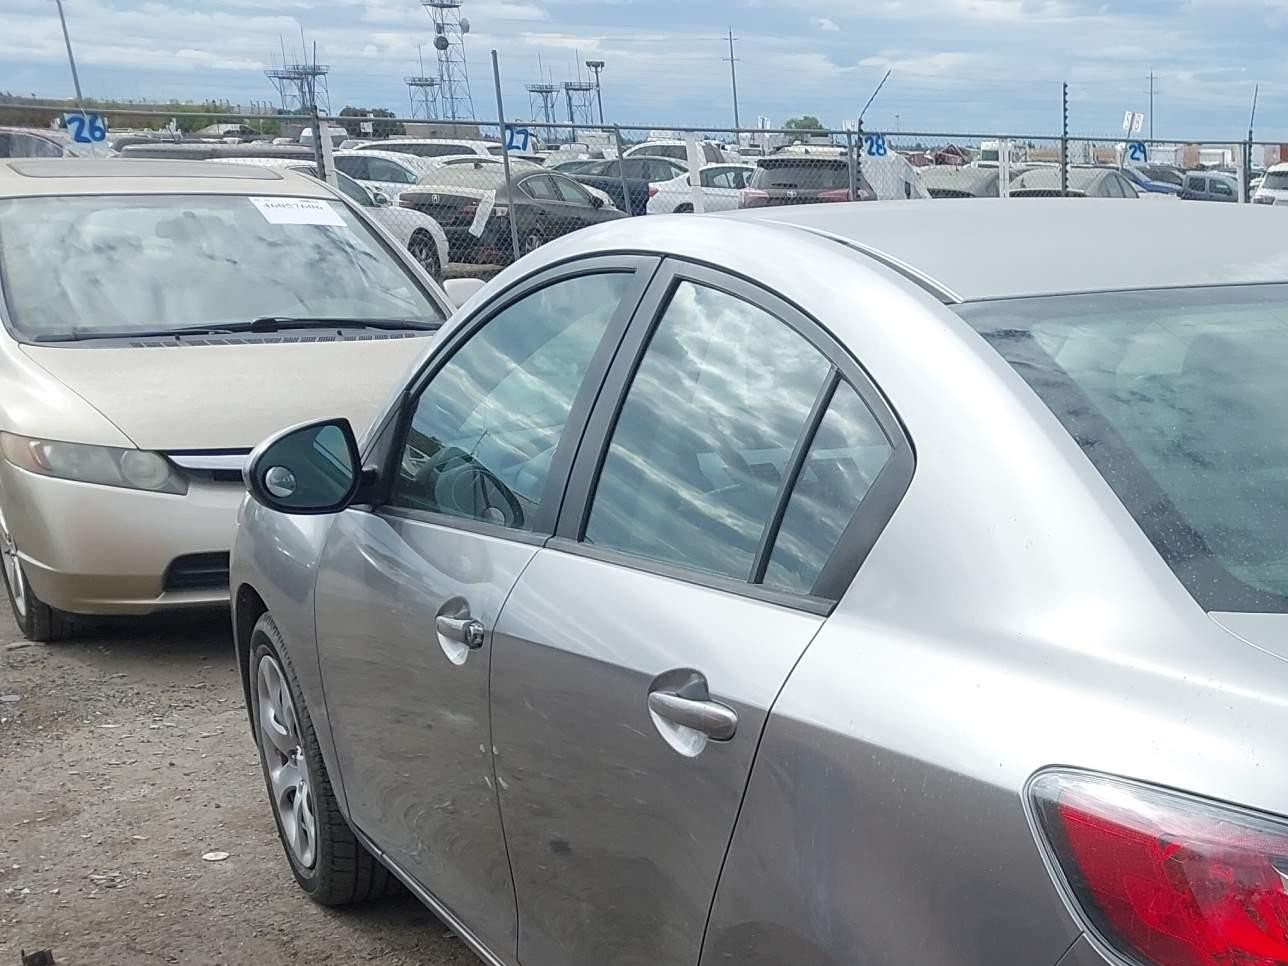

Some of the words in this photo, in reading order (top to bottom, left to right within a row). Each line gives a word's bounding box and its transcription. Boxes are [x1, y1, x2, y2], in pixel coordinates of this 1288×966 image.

[66, 114, 106, 143] 26
[505, 124, 529, 152] 27
[864, 135, 887, 156] 28
[1129, 142, 1148, 163] 29
